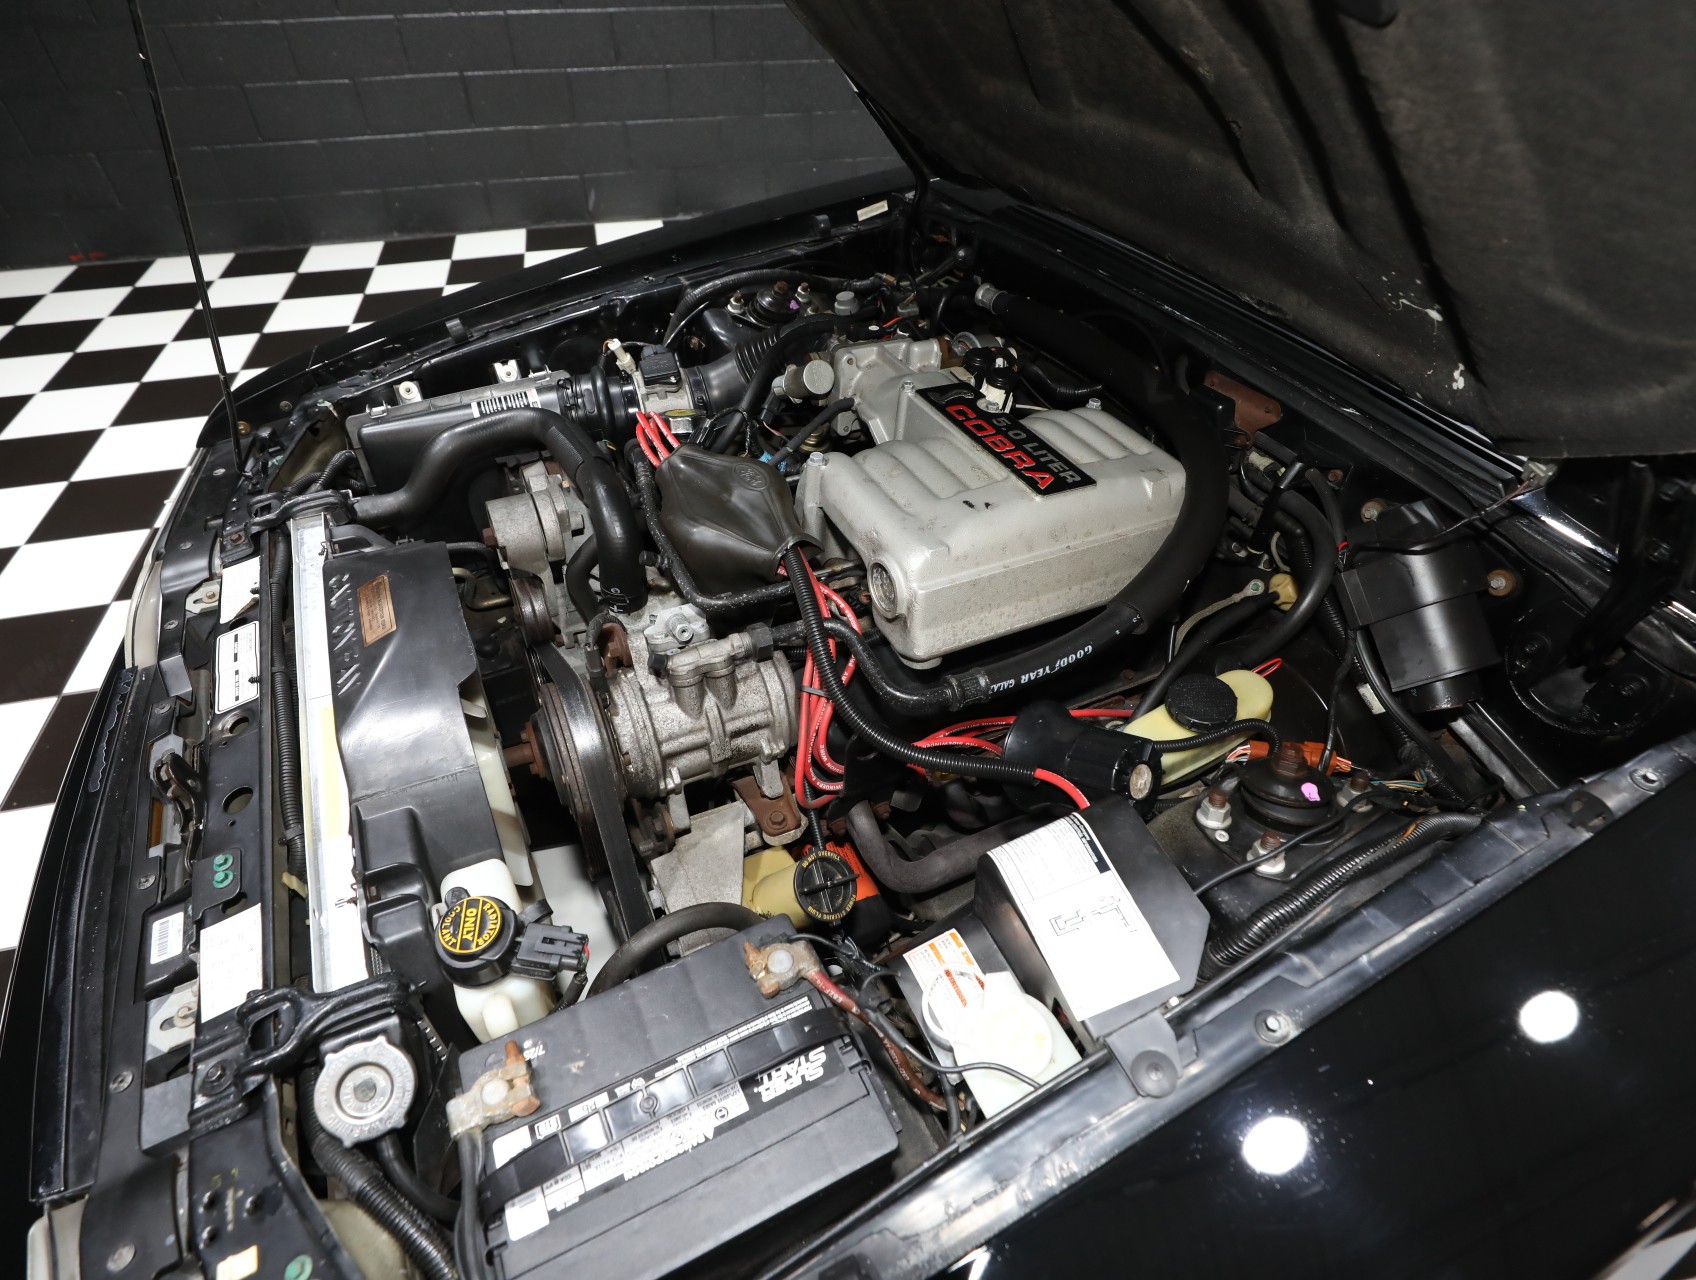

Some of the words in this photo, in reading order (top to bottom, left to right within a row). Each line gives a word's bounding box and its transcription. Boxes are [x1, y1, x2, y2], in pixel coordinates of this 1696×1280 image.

[946, 404, 1055, 490] COBRA
[992, 417, 1027, 440] 5.0
[1022, 442, 1082, 483] LITER
[1020, 645, 1093, 685] GOODYEAR
[989, 678, 1015, 694] GALA
[807, 853, 817, 861] NOT
[818, 850, 840, 861] OVERFILL
[441, 905, 461, 946] COOLANT
[462, 908, 478, 941] ONLY
[476, 903, 498, 946] RADIATOR
[758, 1045, 827, 1092] START
[761, 1065, 824, 1103] SUPER
